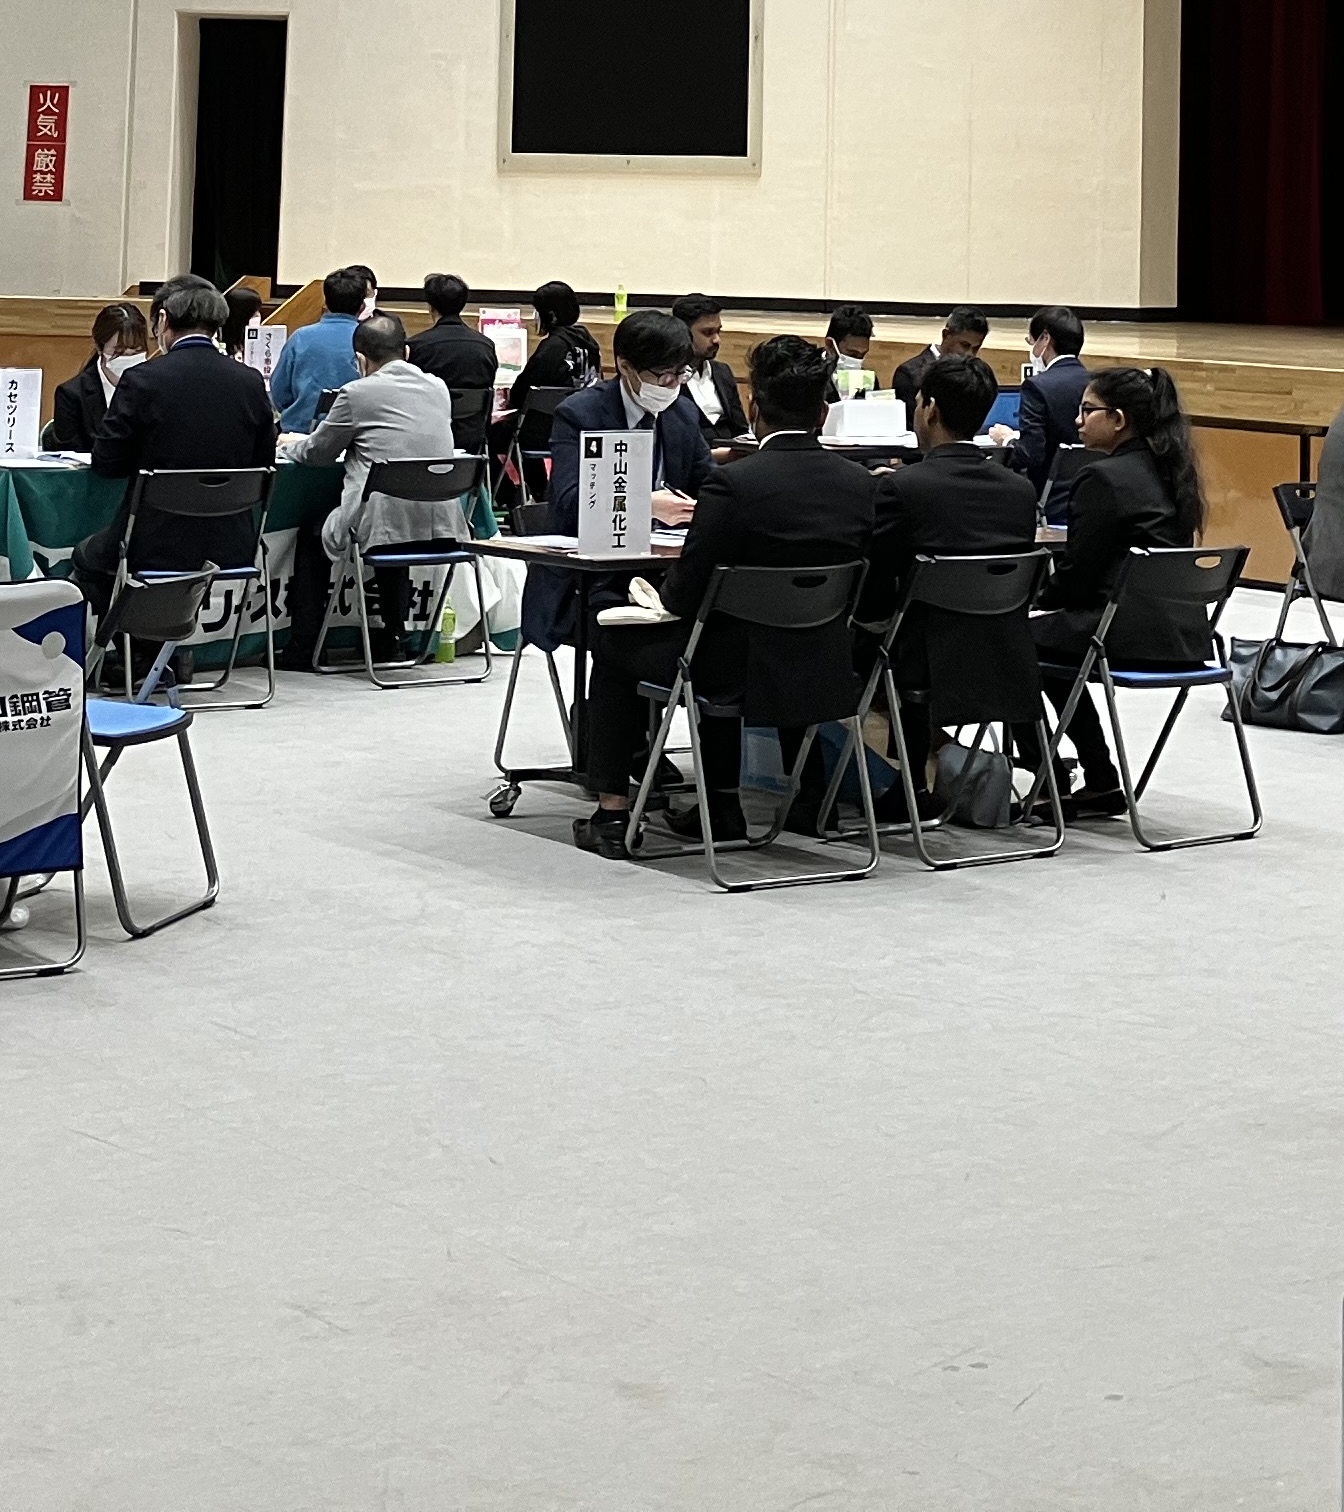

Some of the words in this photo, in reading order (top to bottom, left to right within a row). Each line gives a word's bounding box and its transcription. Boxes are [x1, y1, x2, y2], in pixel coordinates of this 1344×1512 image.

[31, 89, 60, 196] 火気厳禁
[5, 379, 18, 453] カセツリース
[589, 440, 598, 454] 4
[588, 463, 597, 510] マッチング
[611, 439, 628, 549] 中山金属化工
